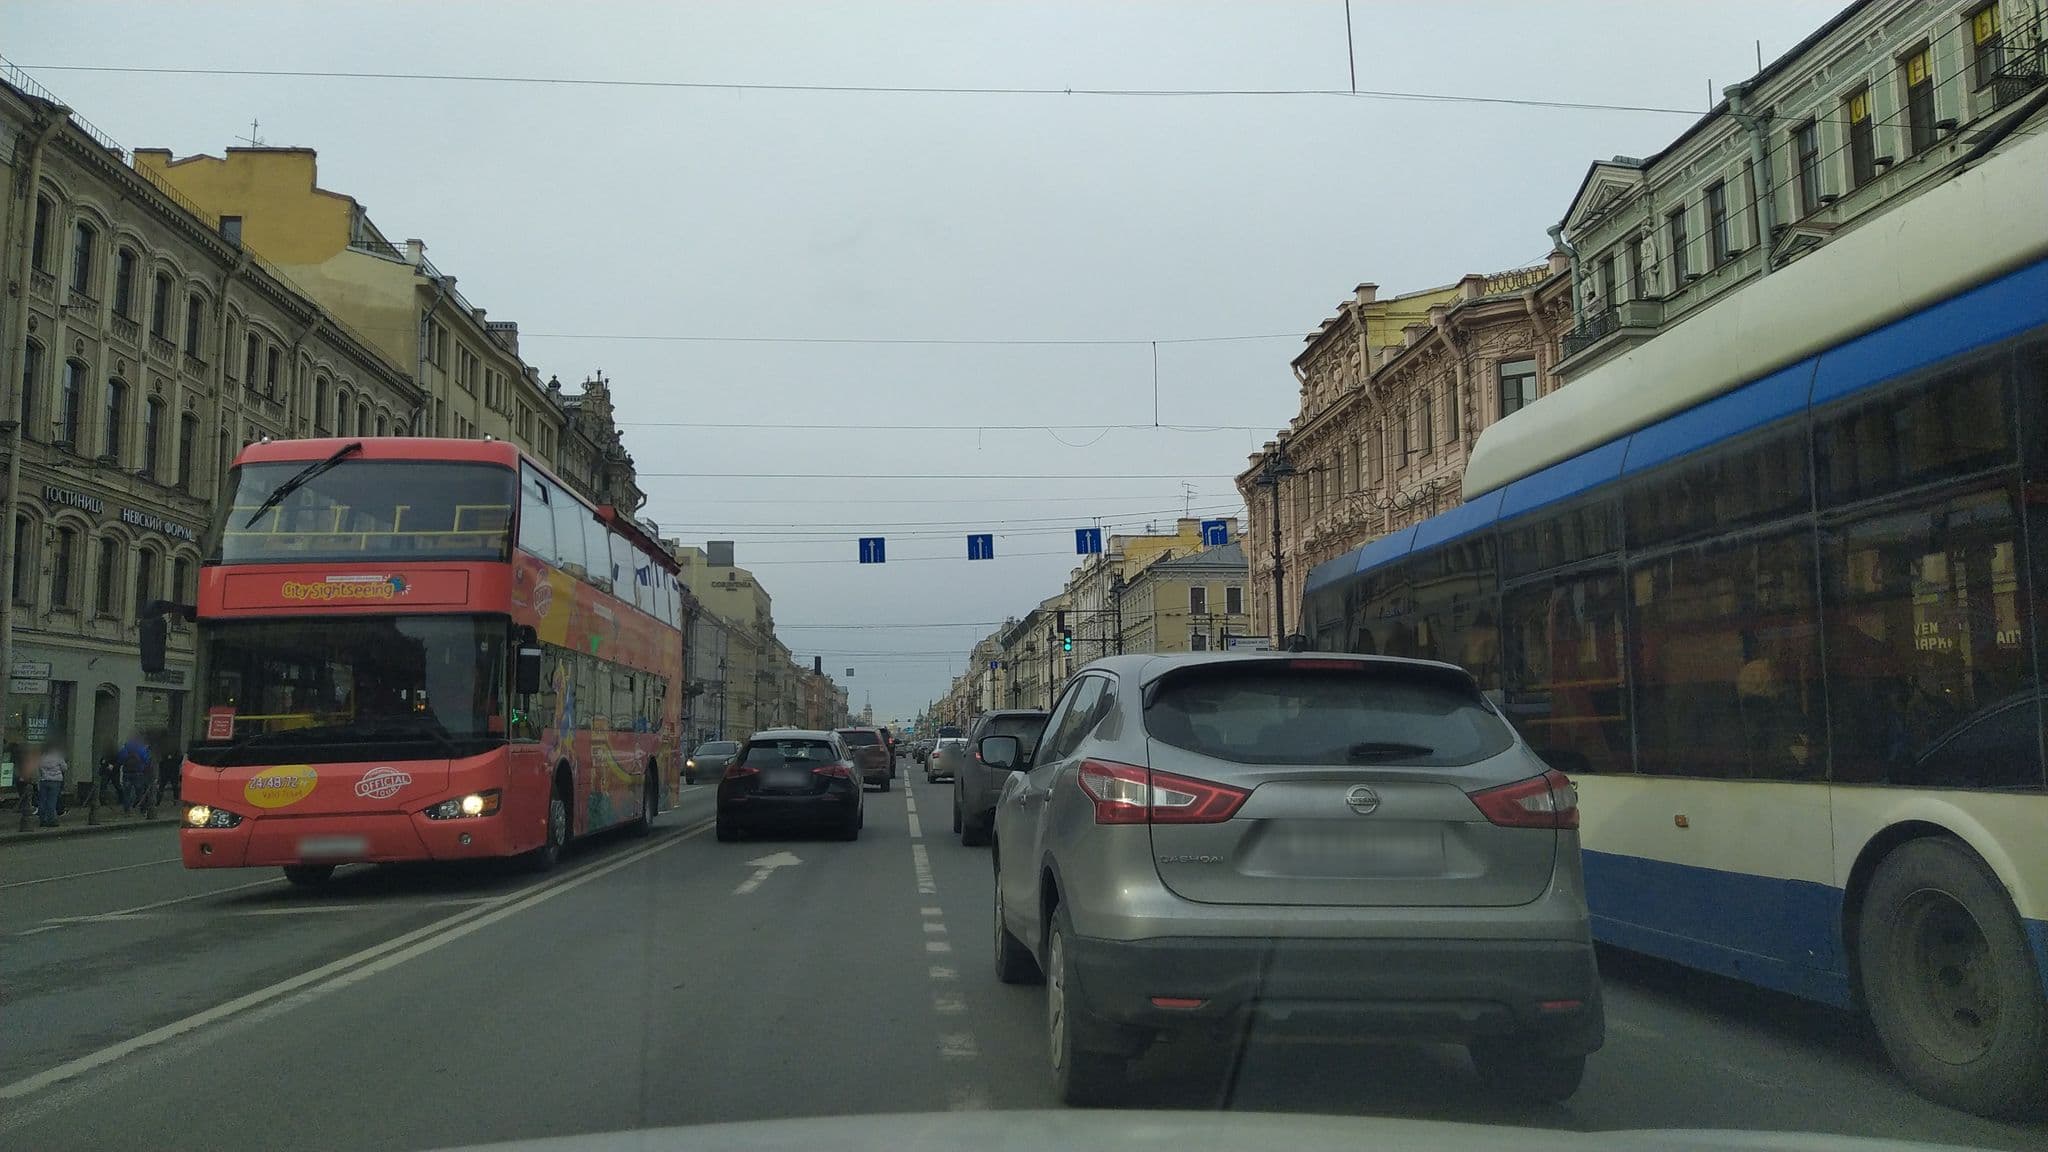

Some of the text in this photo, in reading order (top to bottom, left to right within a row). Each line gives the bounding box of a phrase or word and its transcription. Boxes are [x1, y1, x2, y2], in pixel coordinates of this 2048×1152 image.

[45, 485, 105, 514] ГОСТИНИЦА
[123, 508, 193, 541] НЕВСКИЙ ФОРУМ
[361, 776, 406, 792] OFFICIAL
